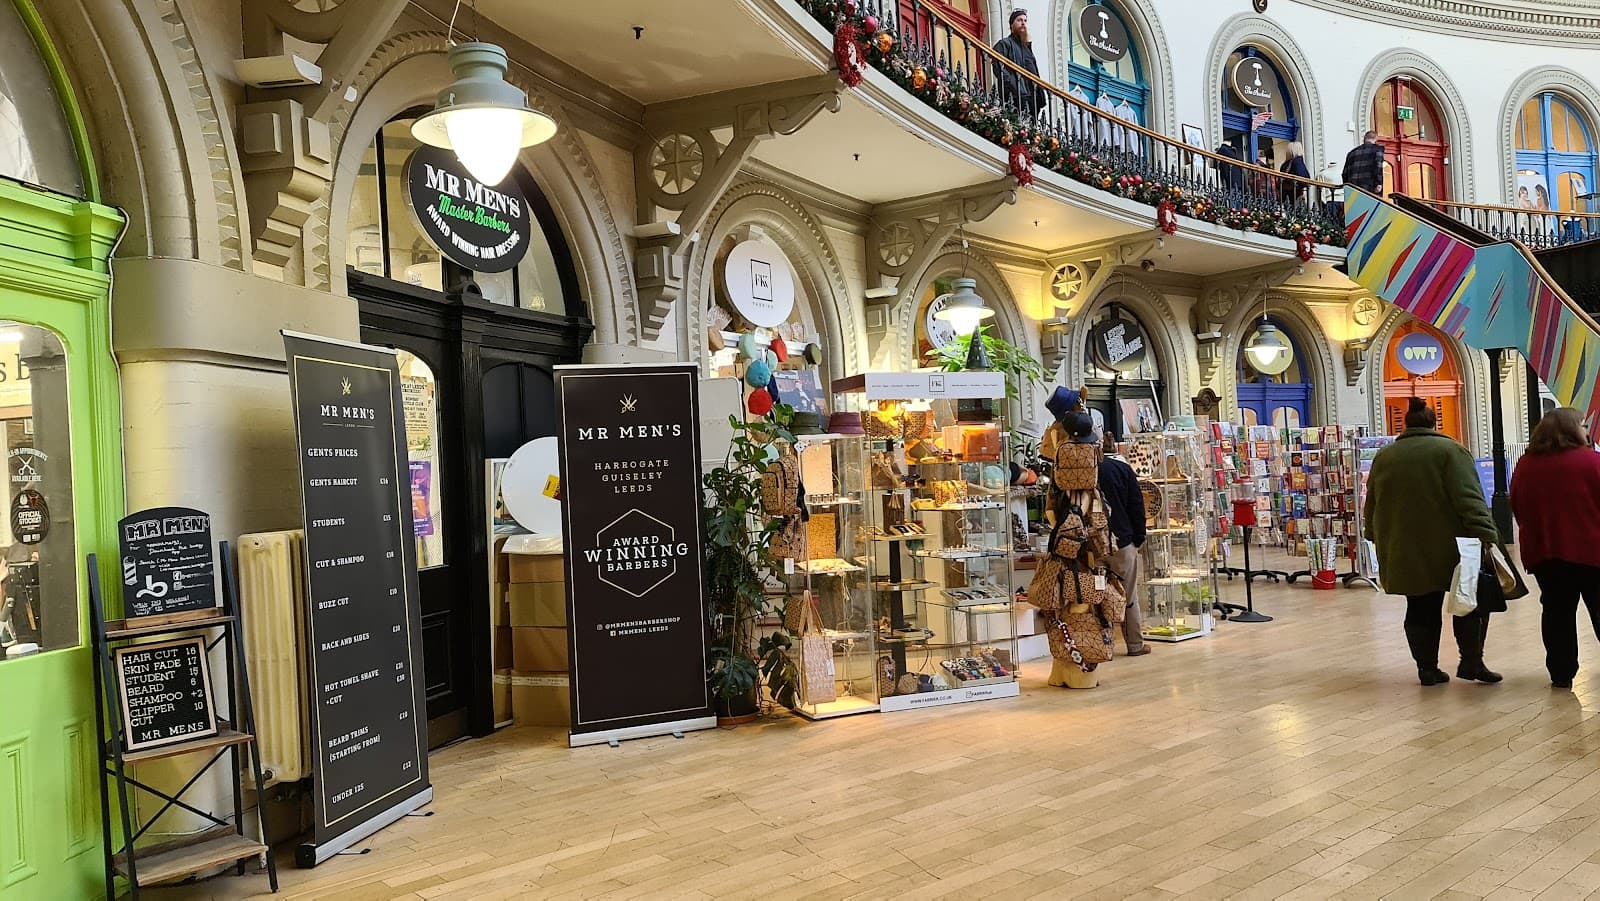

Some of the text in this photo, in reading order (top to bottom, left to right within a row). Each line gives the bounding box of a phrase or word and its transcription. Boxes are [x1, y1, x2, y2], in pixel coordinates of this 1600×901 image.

[424, 164, 521, 218] MR MEN'S
[439, 194, 511, 234] Master Barbers
[426, 204, 520, 259] AWARD WINNING HAIR DRESSING
[1404, 347, 1437, 360] OWT
[320, 404, 375, 420] MR MEN'S
[578, 424, 681, 440] MR MEN'S
[308, 448, 358, 457] GENTS PRICES
[594, 460, 670, 471] HARROGATE
[310, 478, 332, 487] GENTS
[333, 478, 358, 486] HAIRCUT
[602, 471, 663, 482] GUISELEY
[614, 484, 652, 494] LEEDS
[18, 510, 41, 519] OFFICIAL
[124, 519, 161, 541] MR
[312, 518, 345, 528] STUDENTS
[613, 535, 660, 547] AWARD
[584, 543, 689, 563] WINNING
[315, 560, 330, 569] CUT
[336, 555, 365, 566] SHAMPOO
[607, 559, 668, 572] BARBERS
[318, 599, 337, 610] BUZZ
[337, 597, 349, 606] CUT
[618, 625, 669, 636] MRMENS LEEDS
[321, 640, 339, 651] BACK
[340, 637, 353, 647] AND
[353, 632, 370, 643] SIDES
[123, 653, 152, 665] HAIR
[154, 649, 179, 659] CUT
[124, 657, 197, 675] SKIN FADE 17
[126, 667, 199, 686] STUDENT 15
[324, 681, 339, 692] HOT
[339, 675, 360, 688] TOWEL
[360, 669, 380, 681] SHAVE
[127, 684, 165, 696] BEARD
[129, 689, 204, 708] SHAMPOO +2
[326, 694, 343, 705] +CUT
[130, 702, 204, 718] CLIPPER 10
[130, 716, 154, 727] CUT
[141, 722, 204, 741] MR MENS
[328, 734, 350, 748] BEARD
[350, 726, 369, 740] TRIMS
[329, 733, 381, 763] (STARTING FROM)
[332, 788, 353, 804] UNDER
